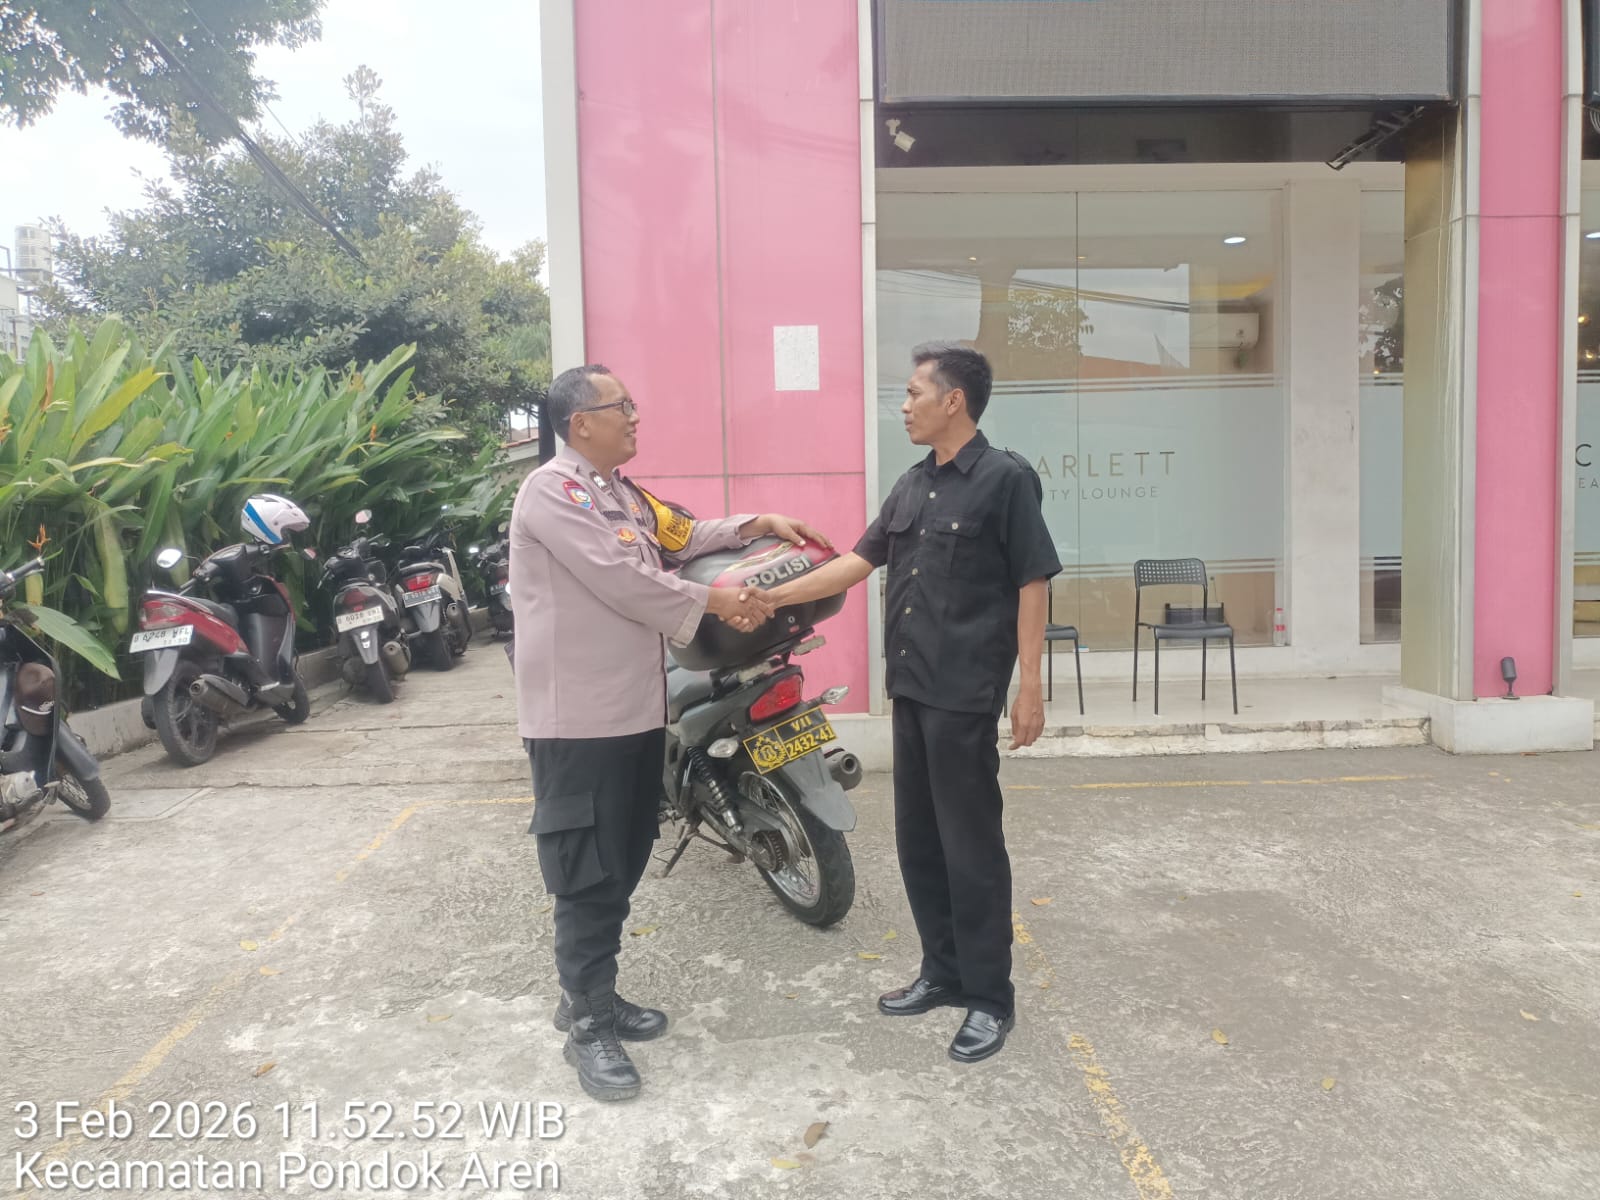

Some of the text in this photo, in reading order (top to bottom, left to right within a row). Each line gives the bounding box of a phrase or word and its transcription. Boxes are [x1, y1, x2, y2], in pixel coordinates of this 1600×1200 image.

[1036, 451, 1176, 479] ARLETT
[1081, 485, 1160, 501] LOUNGE
[745, 552, 811, 588] POLISI
[790, 715, 813, 732] VII
[786, 725, 836, 757] 2432-41
